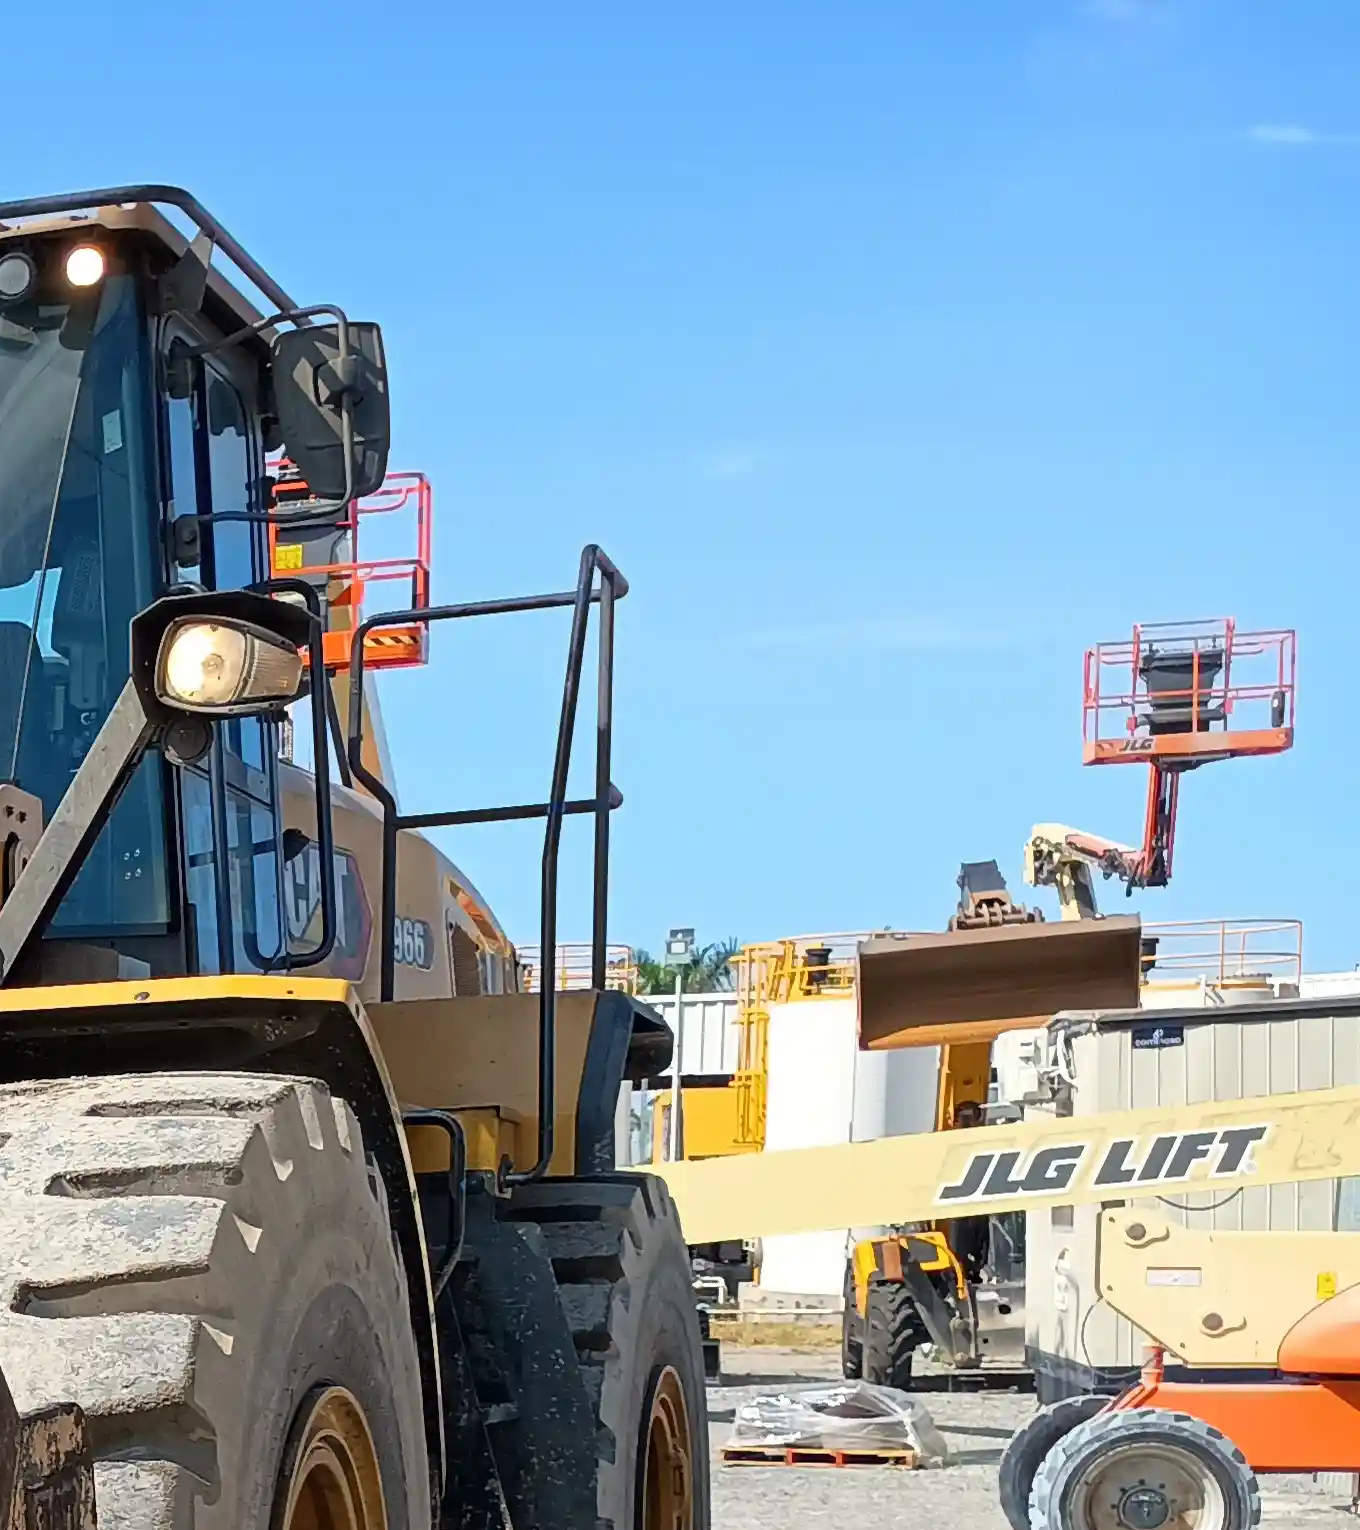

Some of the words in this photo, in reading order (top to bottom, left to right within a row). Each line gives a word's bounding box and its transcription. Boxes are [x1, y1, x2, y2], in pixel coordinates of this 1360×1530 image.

[1118, 737, 1155, 752] JLG
[393, 916, 426, 965] 966
[939, 1144, 1085, 1200] JLG
[1093, 1126, 1268, 1185] LIFT
